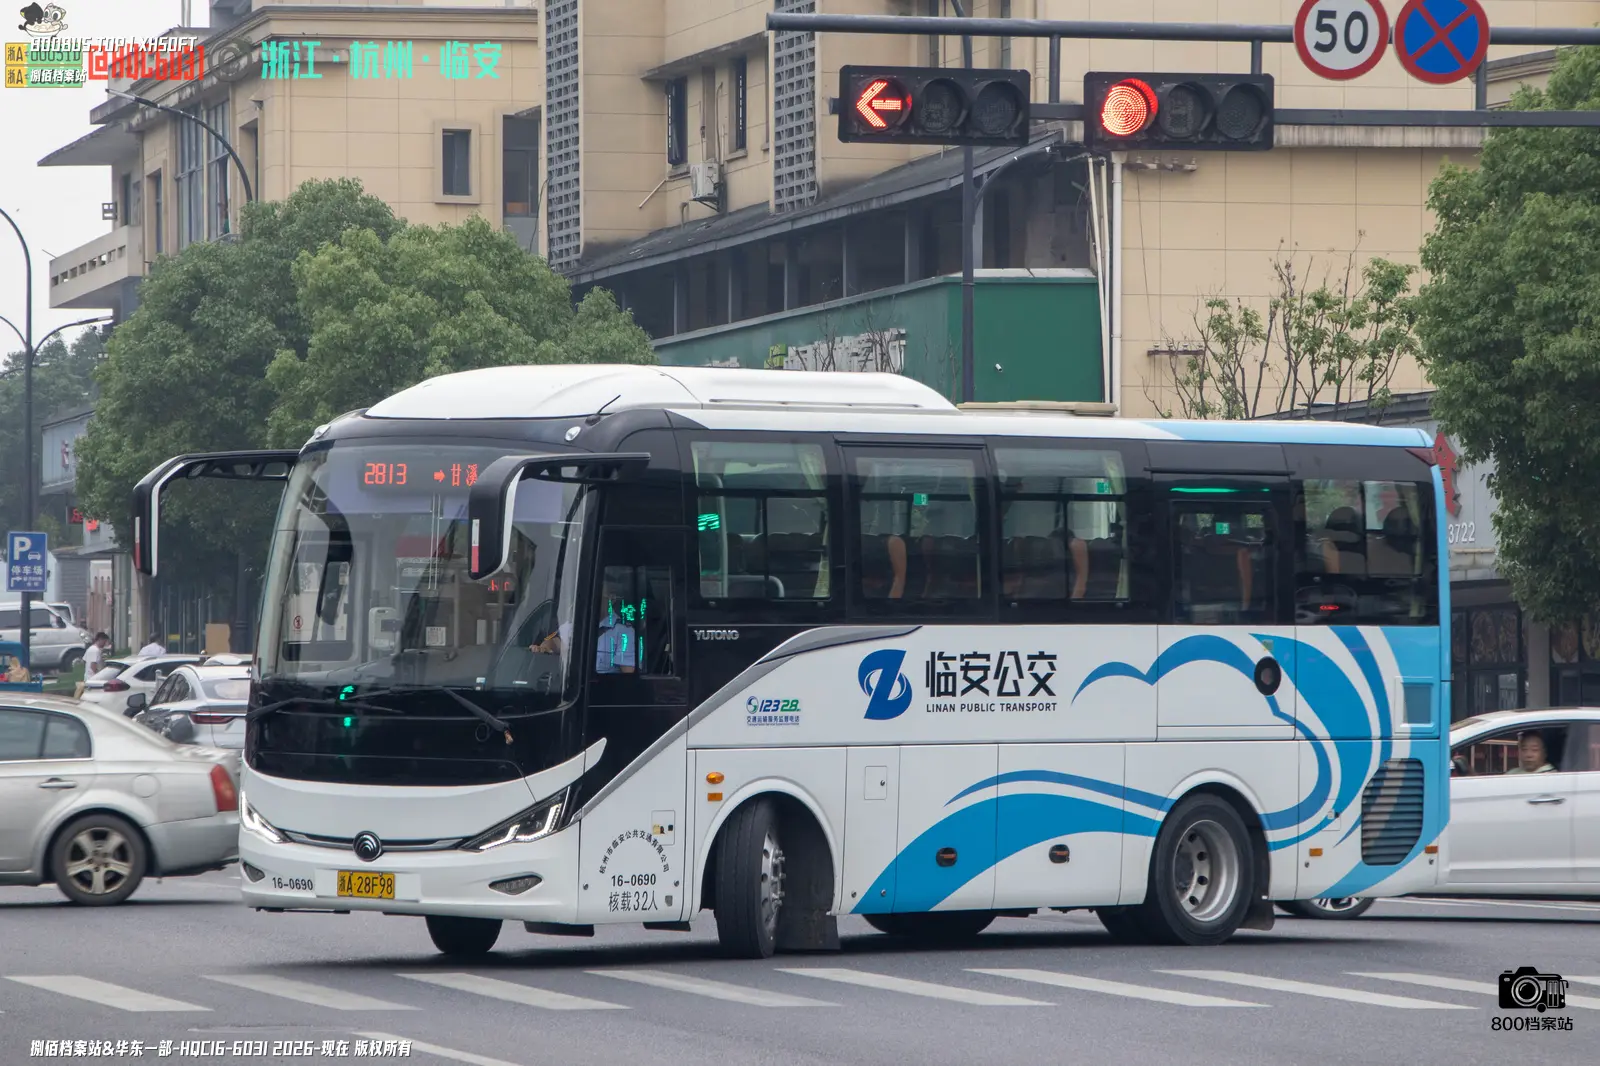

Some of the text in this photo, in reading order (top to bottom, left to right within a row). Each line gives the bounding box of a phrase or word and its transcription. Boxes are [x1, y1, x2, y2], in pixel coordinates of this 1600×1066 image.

[1313, 10, 1369, 54] 50
[364, 463, 408, 485] 2813
[1448, 521, 1476, 543] 3722
[14, 536, 31, 561] P
[694, 629, 740, 641] YUTONG
[925, 651, 1057, 697] 临安公交
[926, 702, 1057, 713] LINAN PUBLIC TRANSPORT
[272, 877, 314, 891] 16-0690
[611, 873, 657, 887] 16-0690
[608, 890, 658, 912] 核载32人
